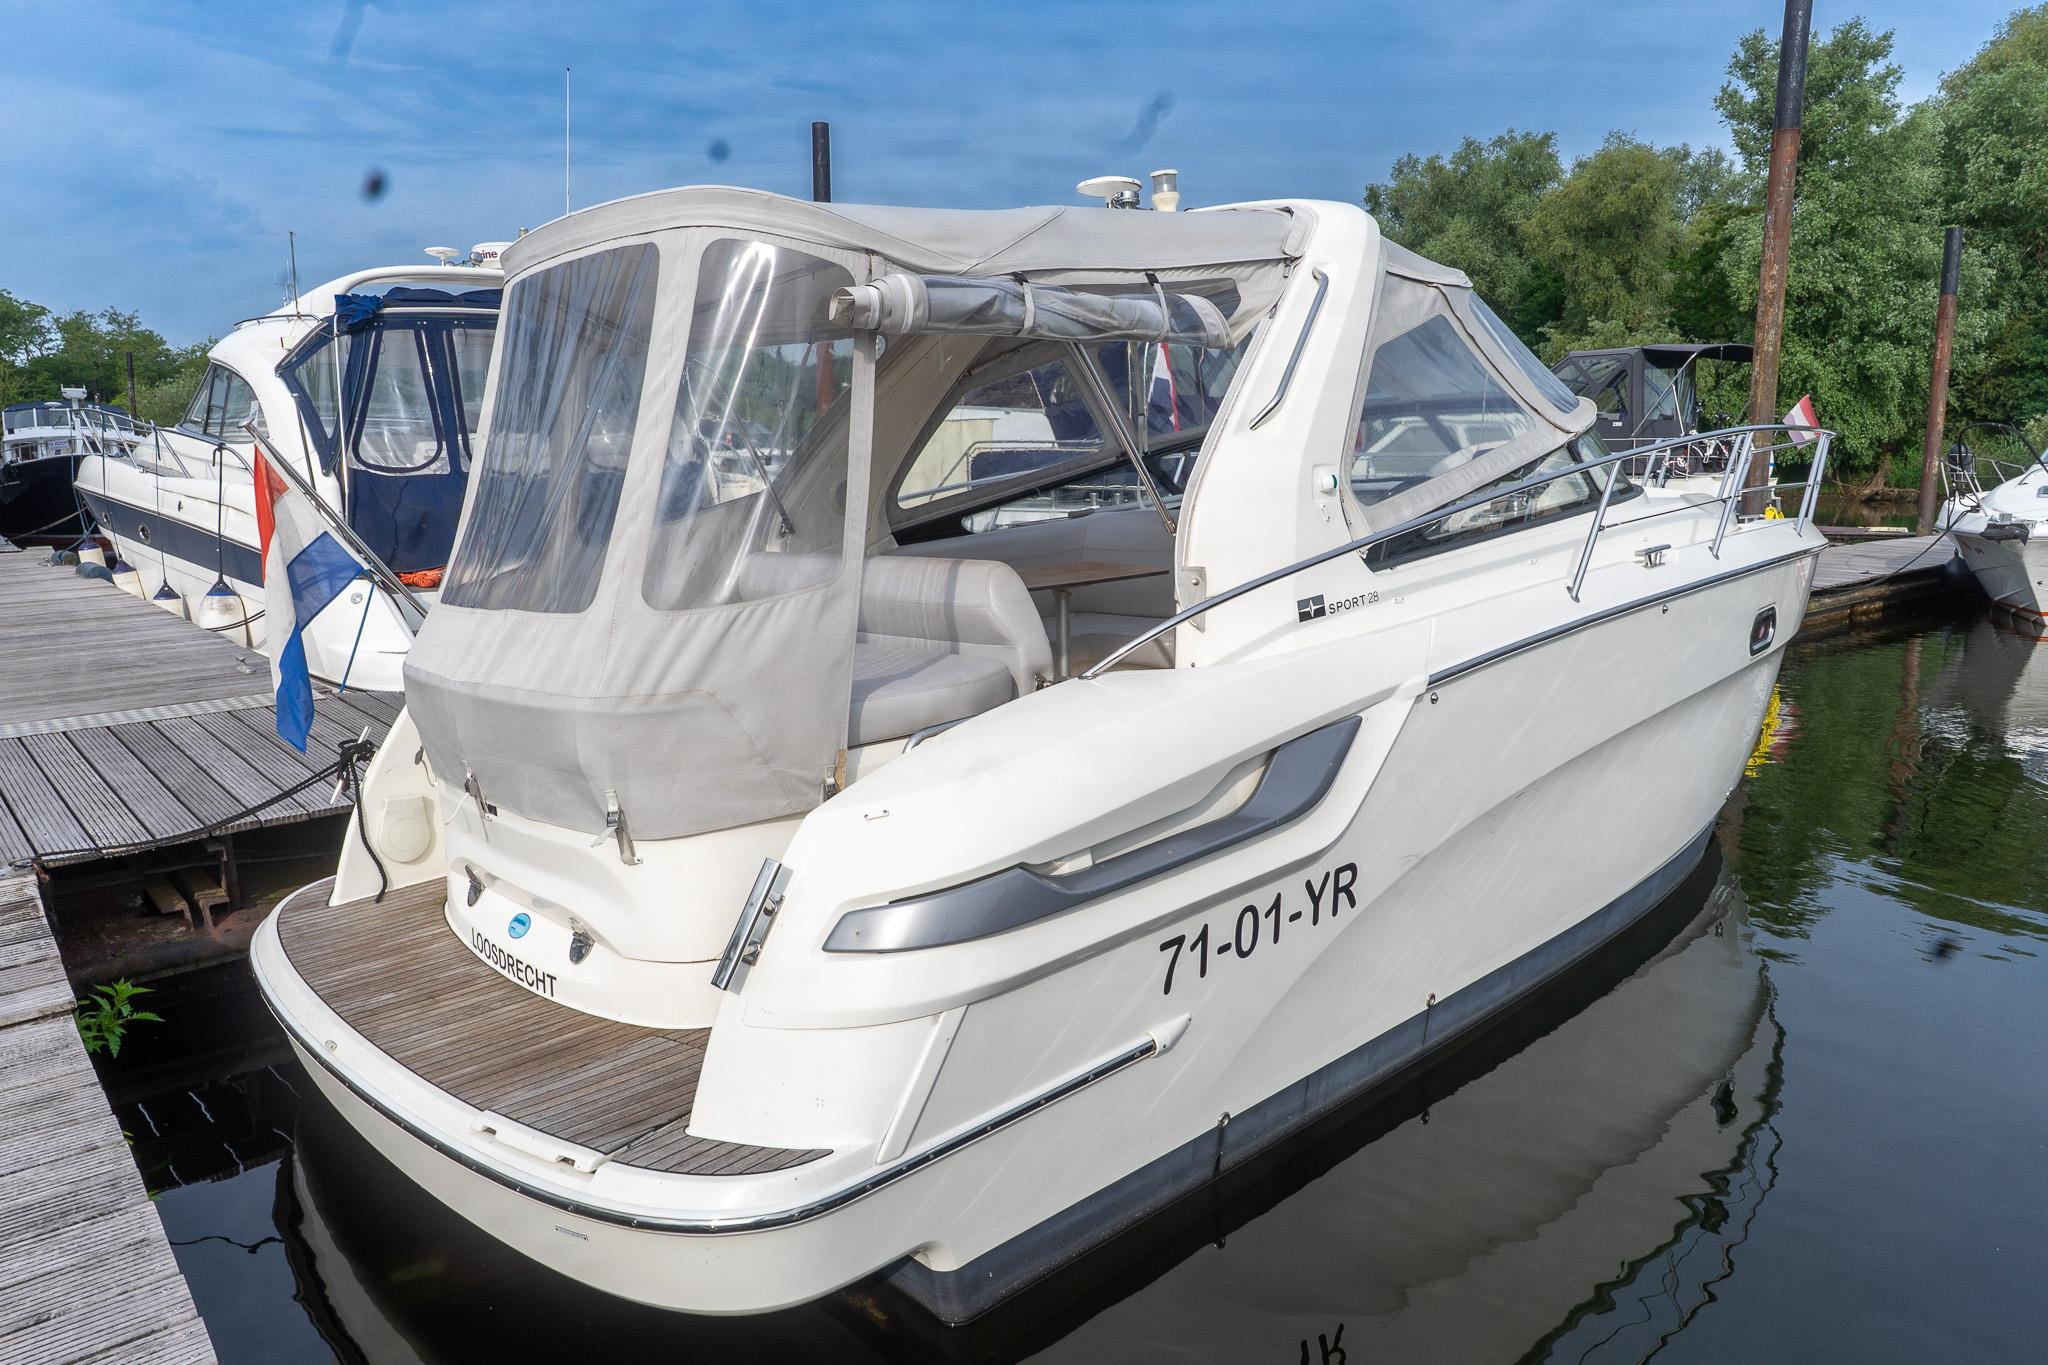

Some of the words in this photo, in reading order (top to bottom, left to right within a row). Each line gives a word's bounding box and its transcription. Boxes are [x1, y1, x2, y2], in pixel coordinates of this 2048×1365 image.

[480, 250, 498, 258] ine
[1328, 594, 1366, 615] SPORT
[1367, 590, 1380, 604] 28
[1159, 862, 1358, 996] 71-01-YR
[471, 927, 557, 998] LOOSDRECHT
